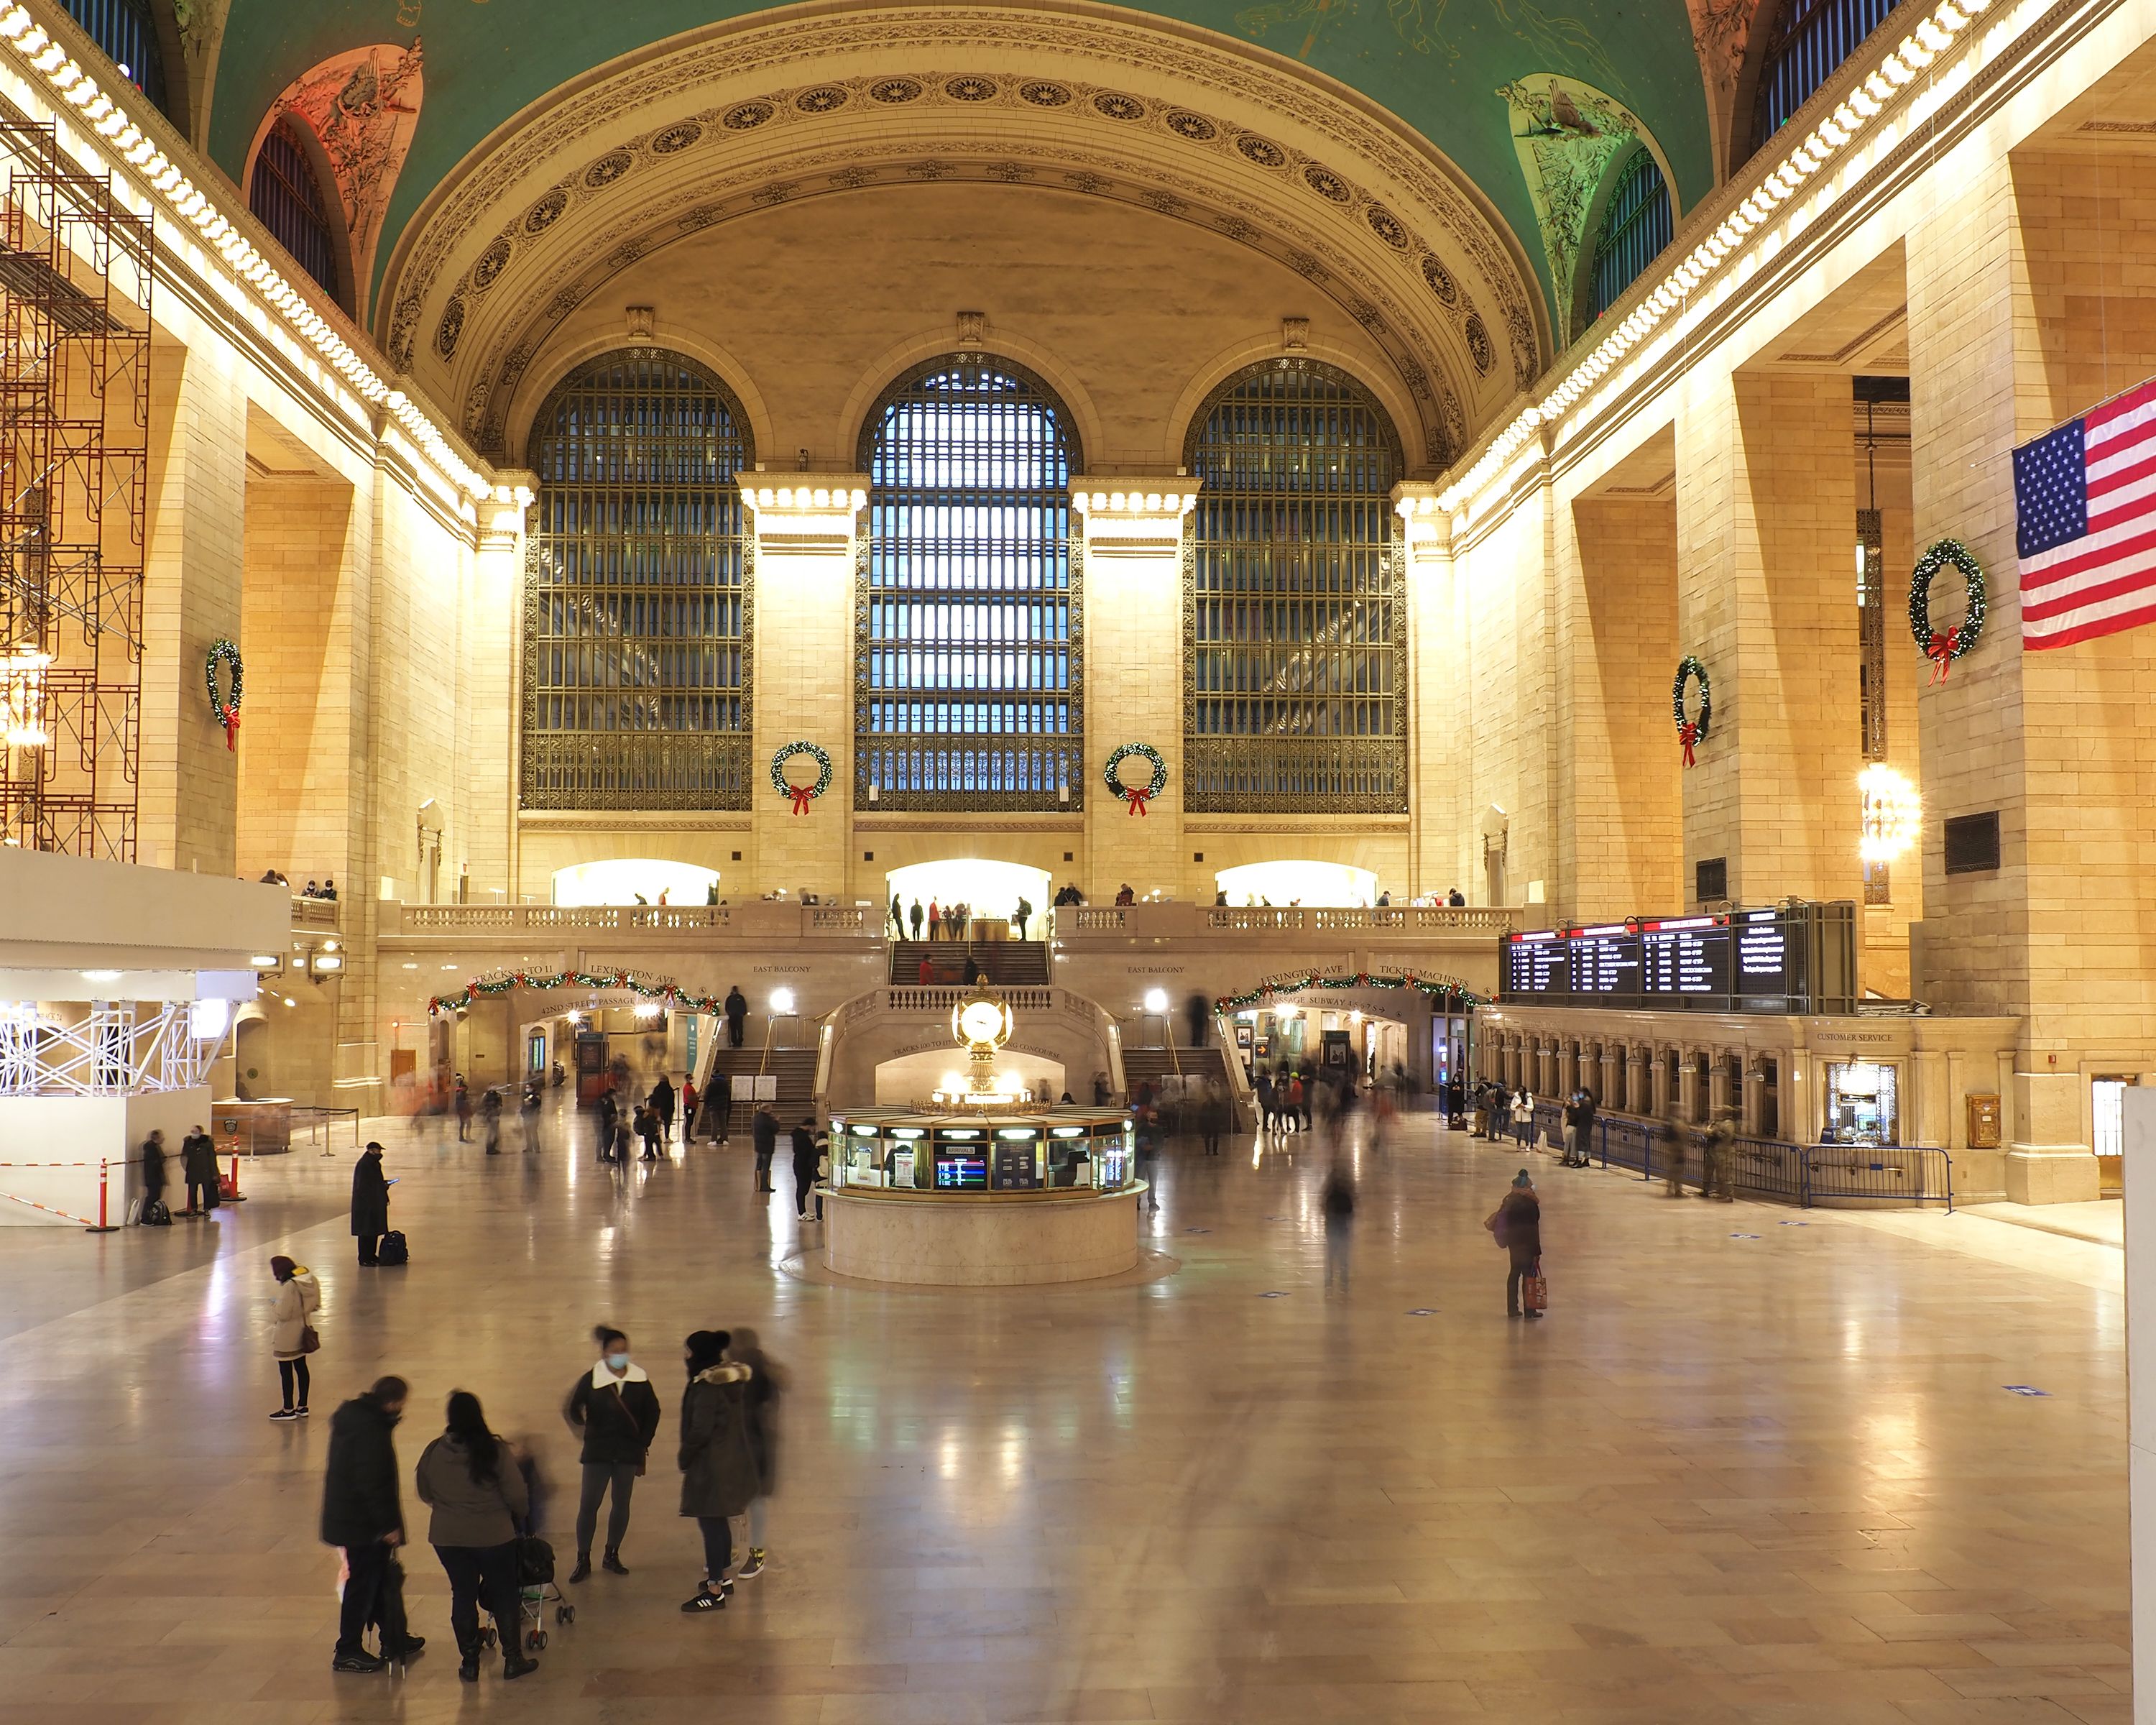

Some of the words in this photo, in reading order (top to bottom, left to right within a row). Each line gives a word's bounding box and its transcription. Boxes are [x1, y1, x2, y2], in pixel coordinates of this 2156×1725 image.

[473, 969, 515, 983] TRACKS
[528, 966, 543, 975] TO
[591, 965, 653, 980] LEXINGTON
[655, 974, 676, 985] AVE
[1261, 967, 1321, 986] LEXINGTON
[1325, 965, 1343, 975] AVE
[1379, 965, 1415, 975] TICKET
[1418, 970, 1470, 988] MACHINES
[541, 1004, 564, 1015] 42ND
[565, 999, 596, 1010] STREET
[1309, 997, 1346, 1006] SUBWAY
[893, 1044, 919, 1056] TRACKS
[1019, 1043, 1061, 1059] CONCOURSE
